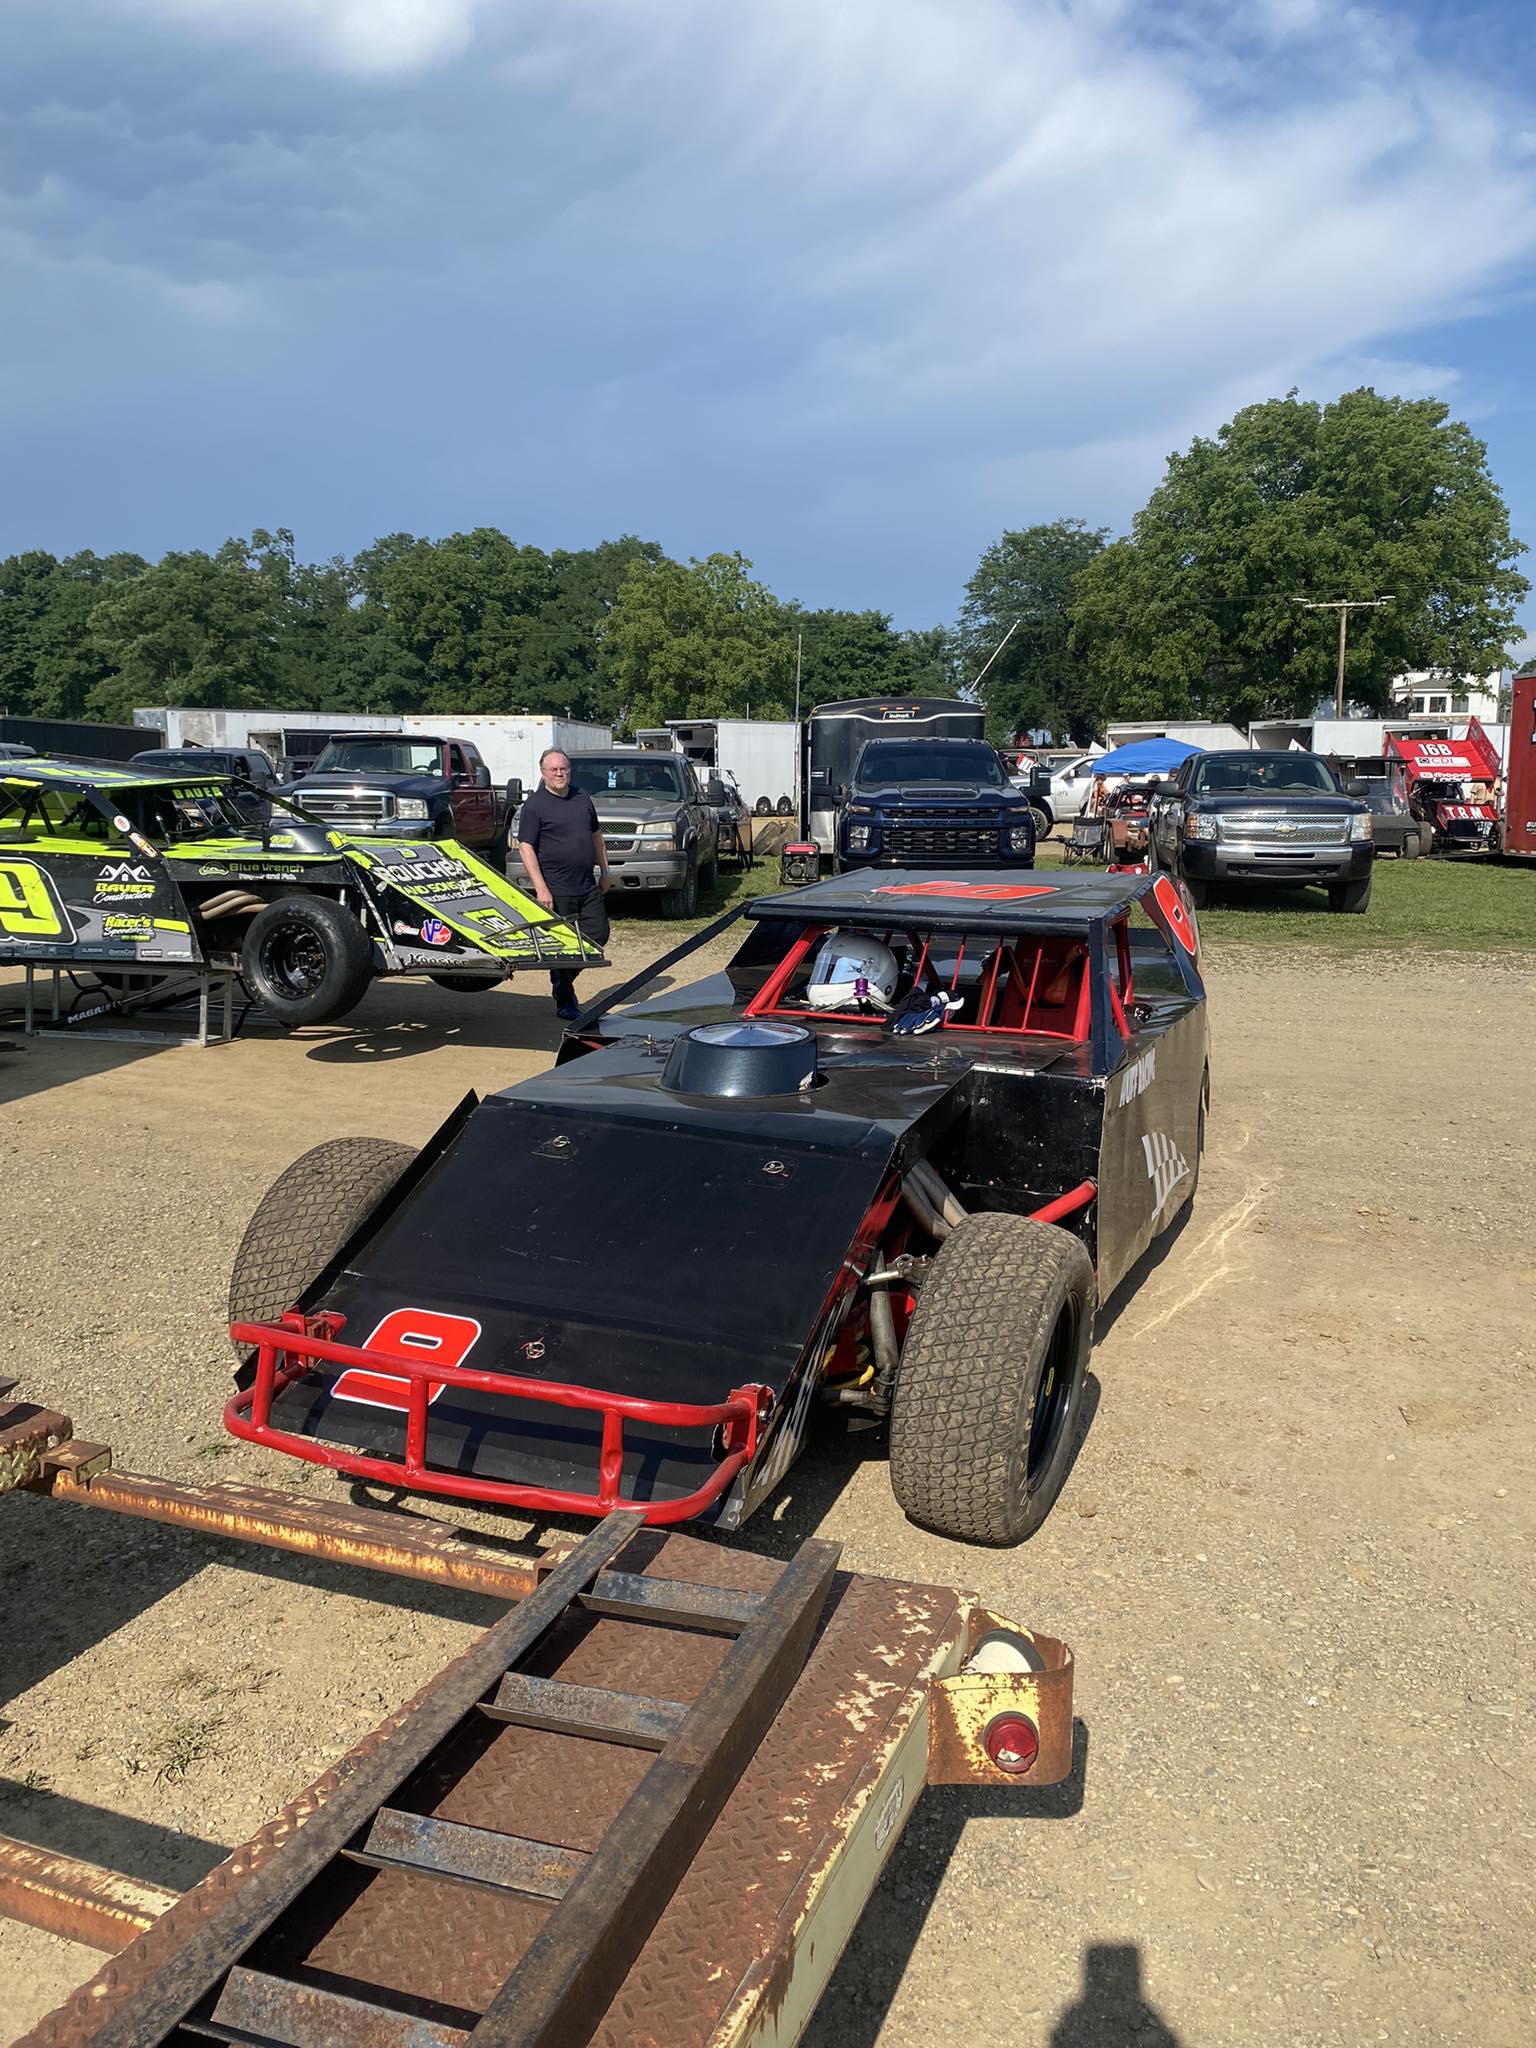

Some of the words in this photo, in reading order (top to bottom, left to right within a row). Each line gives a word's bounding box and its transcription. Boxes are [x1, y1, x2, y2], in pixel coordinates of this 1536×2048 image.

[1418, 743, 1452, 756] 16B
[172, 786, 223, 799] BAUER
[95, 882, 156, 893] BAUER
[93, 891, 153, 904] Construction
[105, 915, 152, 928] Racer's
